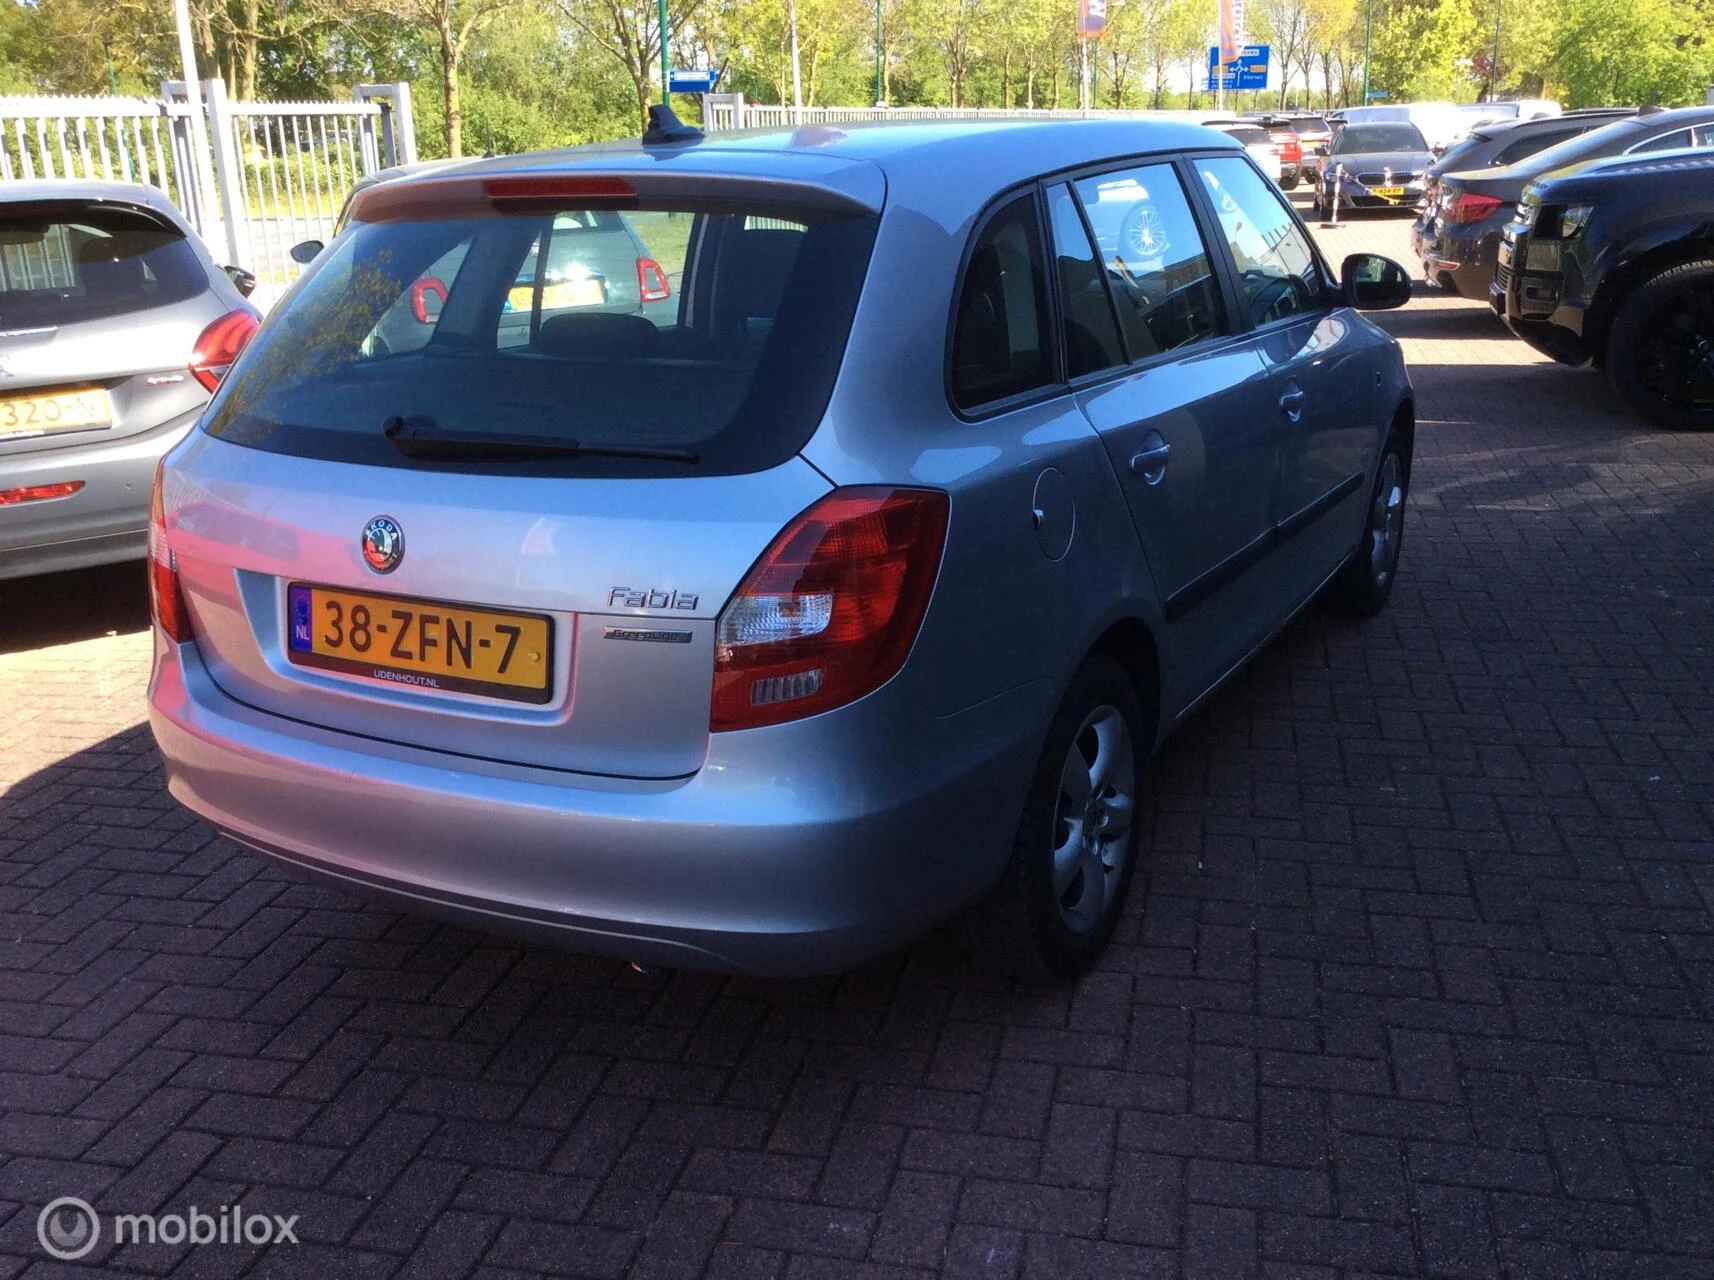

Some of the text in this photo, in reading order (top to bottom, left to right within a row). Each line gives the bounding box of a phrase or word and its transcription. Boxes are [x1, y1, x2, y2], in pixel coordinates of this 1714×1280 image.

[607, 586, 699, 610] Fabia
[295, 624, 310, 641] NL
[323, 600, 522, 674] 38-ZFN-7
[373, 669, 440, 688] UDENHOUT.NL
